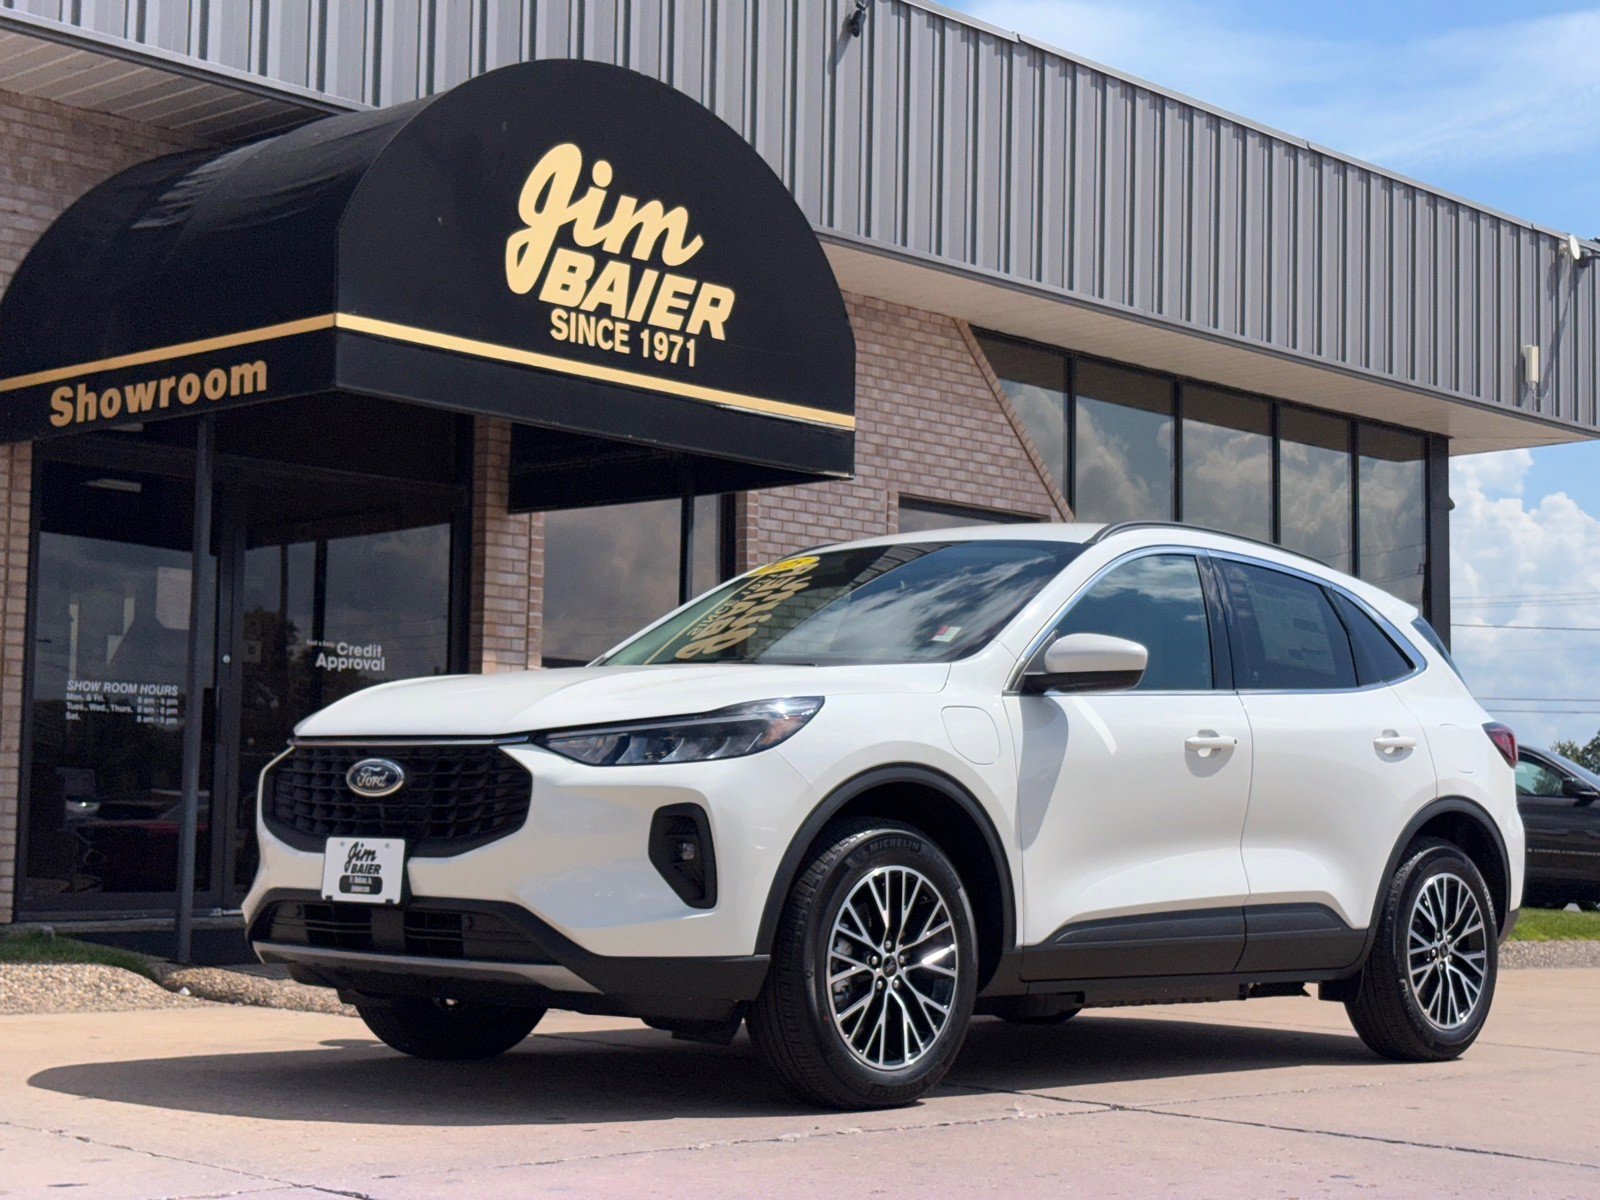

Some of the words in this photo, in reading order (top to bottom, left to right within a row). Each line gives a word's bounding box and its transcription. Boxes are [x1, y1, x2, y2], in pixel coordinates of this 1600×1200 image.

[505, 143, 704, 294] Jim
[538, 248, 735, 341] BAIER
[550, 308, 630, 354] SINCE
[640, 328, 696, 367] 1971
[50, 360, 268, 427] Showroom
[336, 642, 382, 658] Credit
[316, 652, 386, 672] Approval
[67, 680, 101, 692] SHOW
[104, 682, 138, 693] ROOM
[140, 684, 178, 696] HOURS
[356, 766, 389, 788] Ford
[869, 837, 921, 852] MICHELIN
[344, 841, 377, 874] Jim
[350, 863, 382, 875] BAIER
